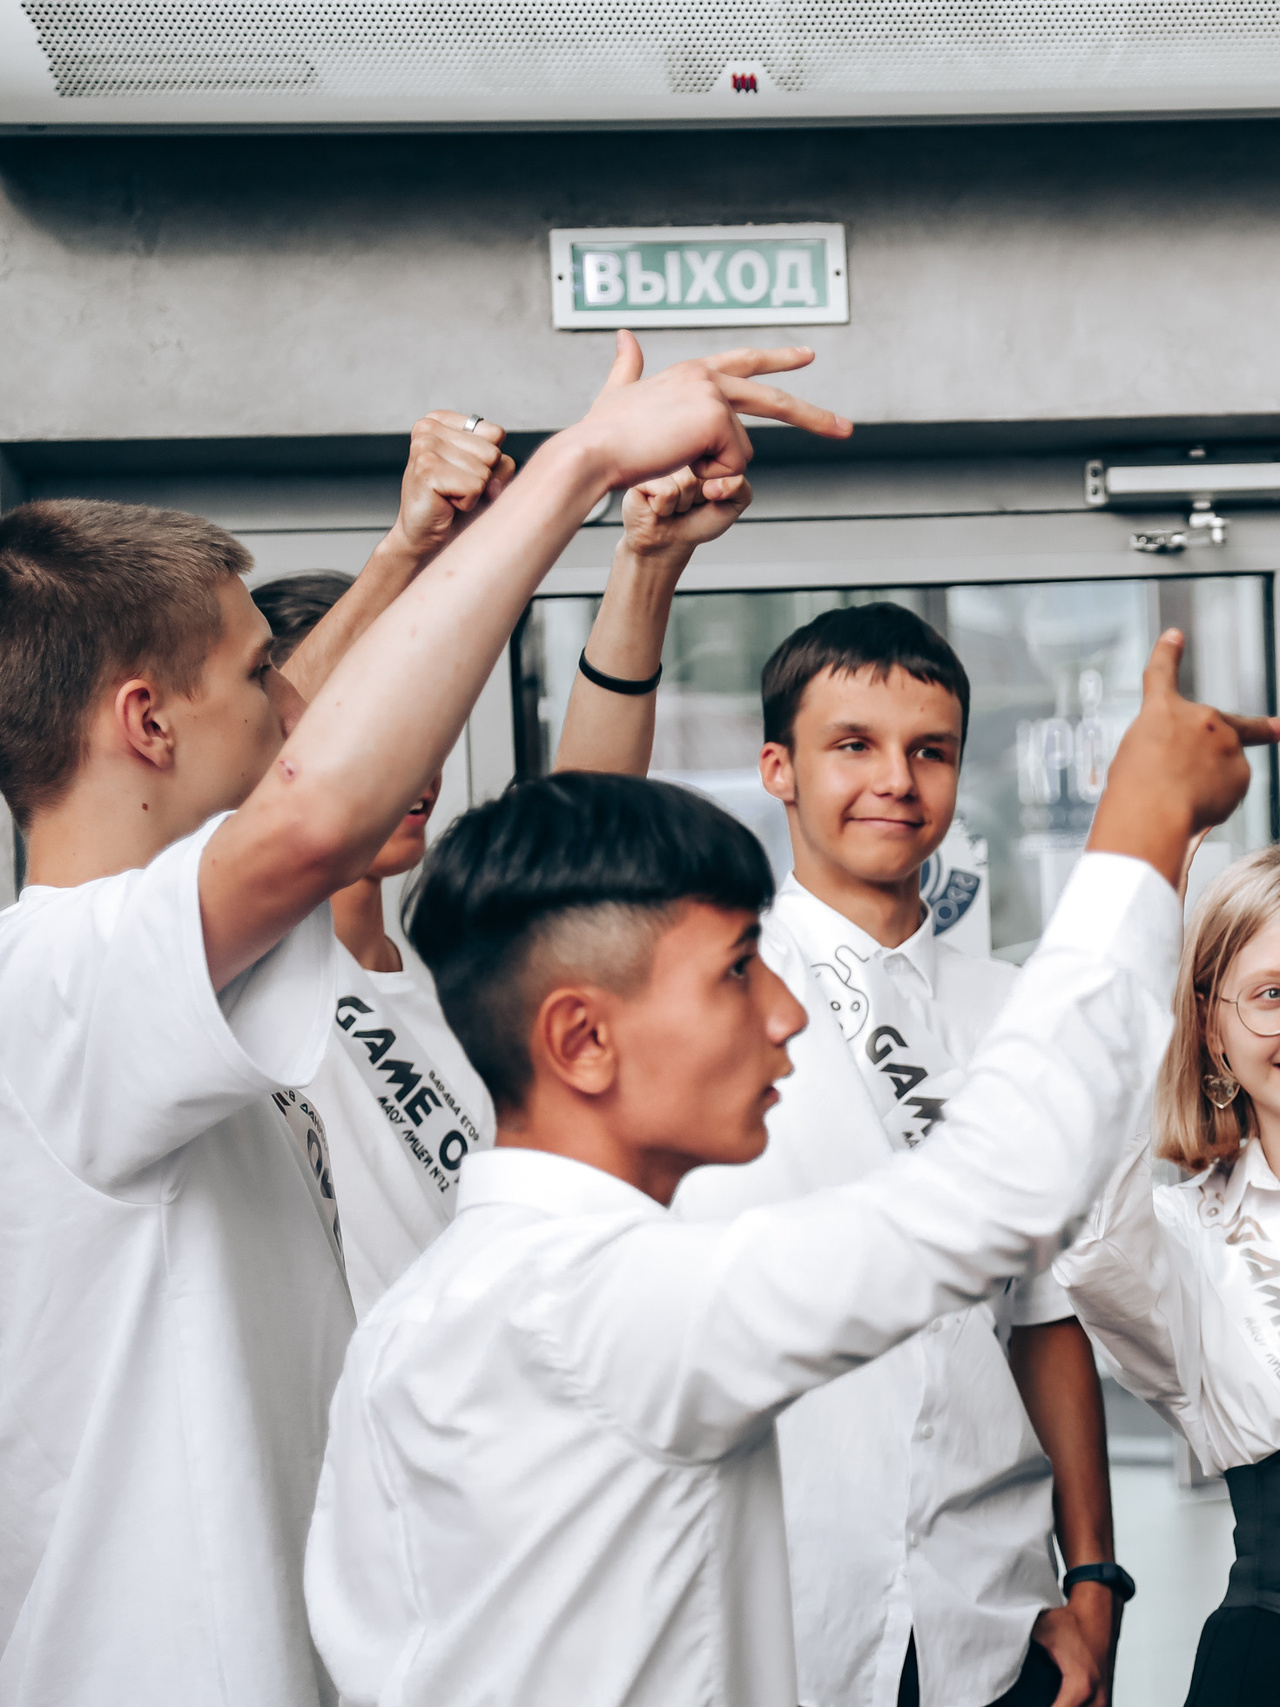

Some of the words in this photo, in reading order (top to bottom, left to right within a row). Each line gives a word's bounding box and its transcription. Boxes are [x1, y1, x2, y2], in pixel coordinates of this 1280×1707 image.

[583, 249, 818, 306] ВЫХОД
[336, 996, 443, 1126] GAME
[377, 1096, 406, 1124] МАОУ
